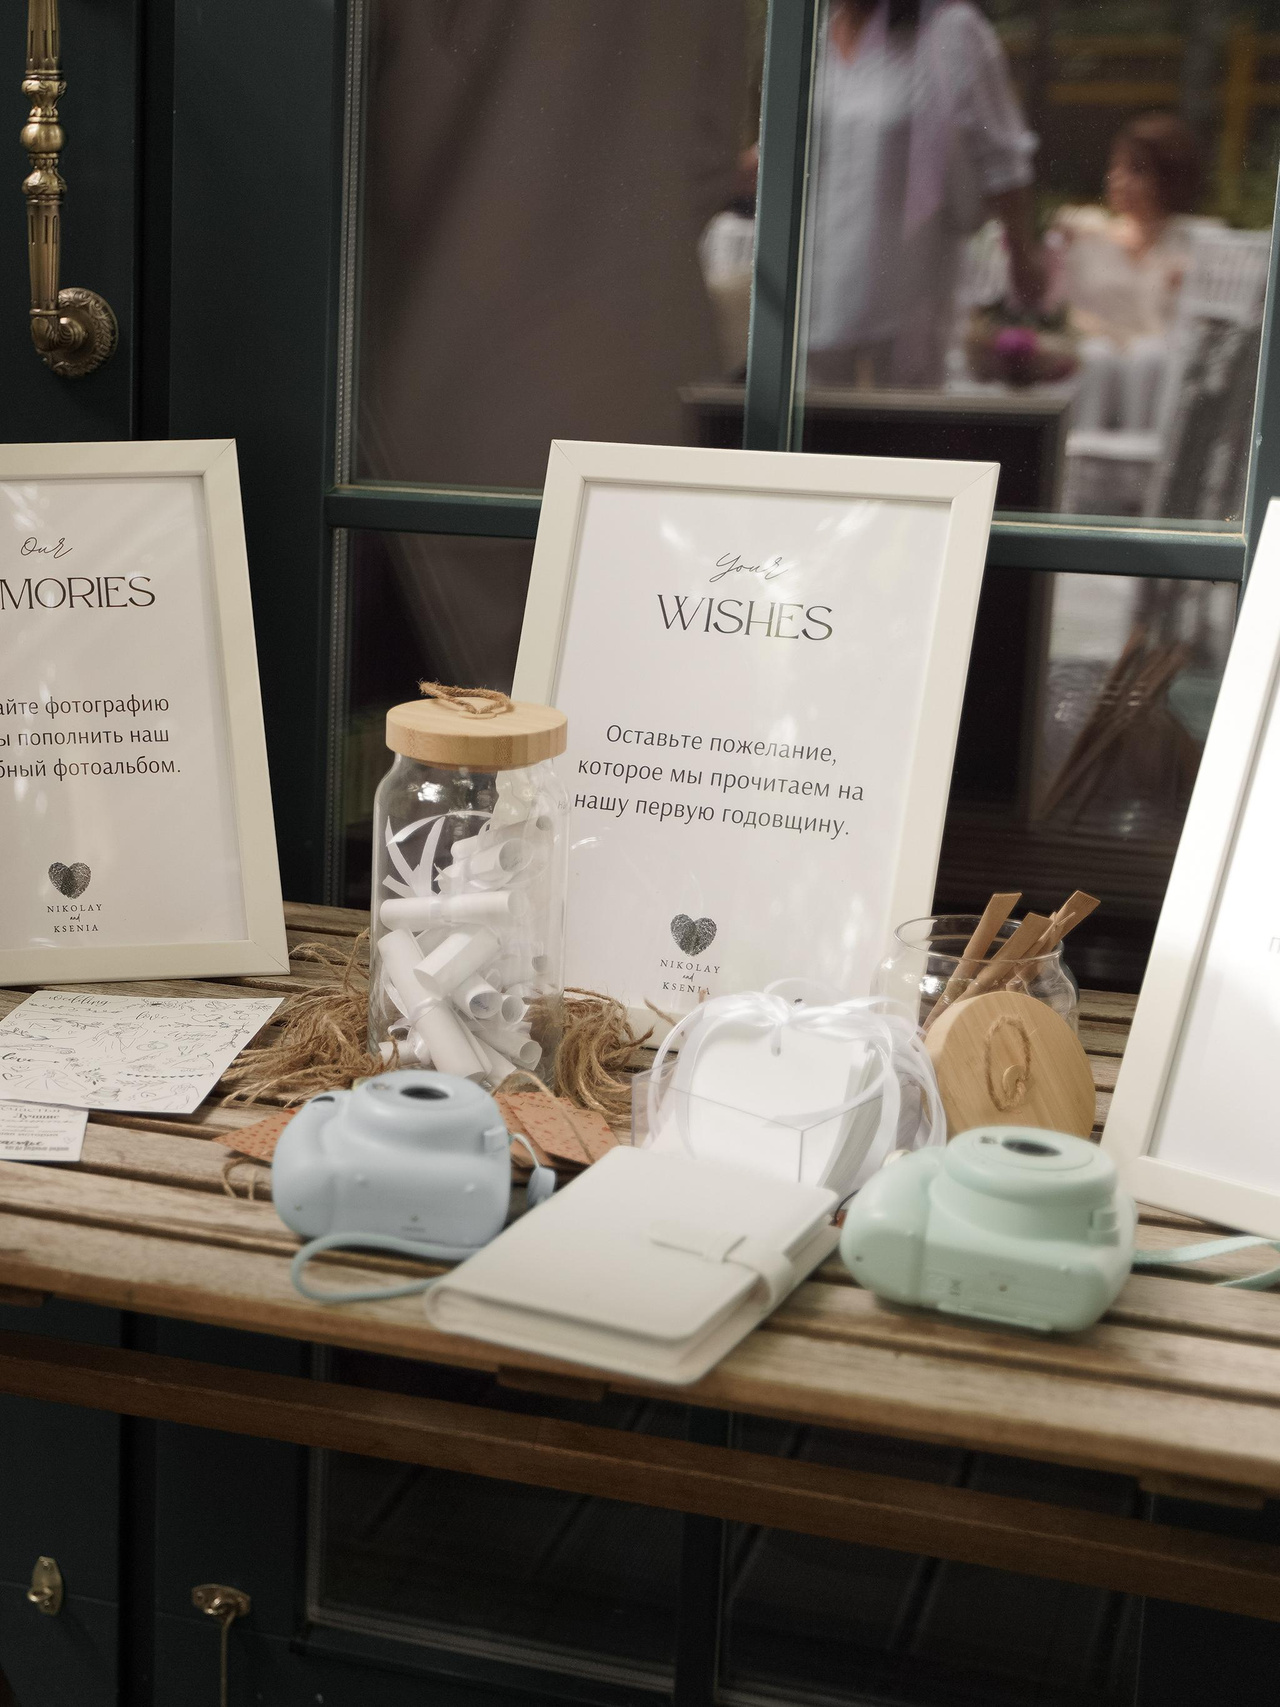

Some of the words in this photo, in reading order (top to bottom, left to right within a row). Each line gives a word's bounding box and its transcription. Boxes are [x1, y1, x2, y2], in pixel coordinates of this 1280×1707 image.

[657, 593, 834, 642] WISHES
[44, 694, 170, 720] фотографию
[17, 728, 124, 747] пополнить
[129, 729, 170, 744] наш
[606, 724, 703, 751] Оставьте
[710, 737, 837, 767] пожелание,
[53, 756, 181, 782] фотоальбом.
[577, 759, 664, 785] которое
[670, 768, 703, 786] мы
[710, 771, 830, 798] прочитаем
[837, 784, 864, 802] на
[574, 793, 630, 819] нашу
[635, 799, 715, 826] первую
[721, 808, 849, 841] годовщину.
[46, 903, 103, 914] NIKOLAY
[53, 923, 99, 934] KSENIA
[659, 958, 721, 974] NIKOLAY
